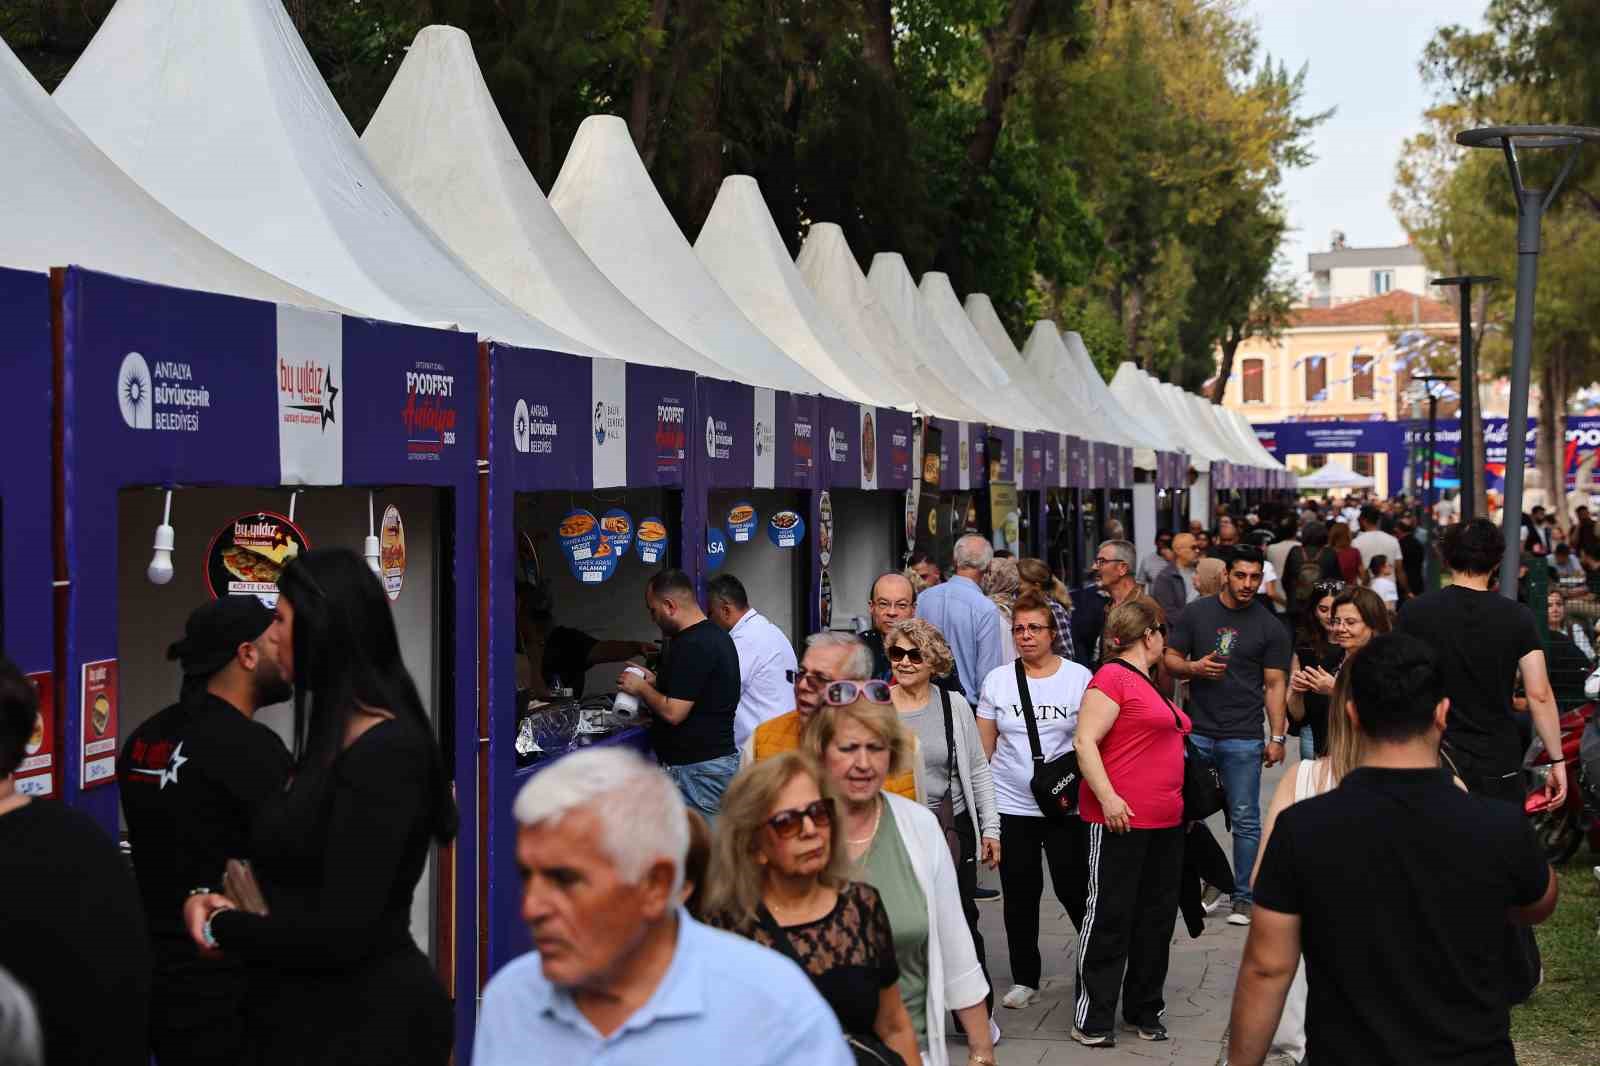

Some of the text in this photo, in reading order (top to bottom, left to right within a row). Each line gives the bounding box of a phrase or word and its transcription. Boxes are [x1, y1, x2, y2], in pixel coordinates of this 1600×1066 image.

[154, 361, 193, 381] ANTALYA
[280, 358, 294, 400] by
[154, 382, 210, 410] BÜYÜKŞEHİR
[406, 371, 454, 397] FOODFEST
[155, 409, 199, 431] BELEDİYESİ
[1051, 772, 1076, 795] adidas
